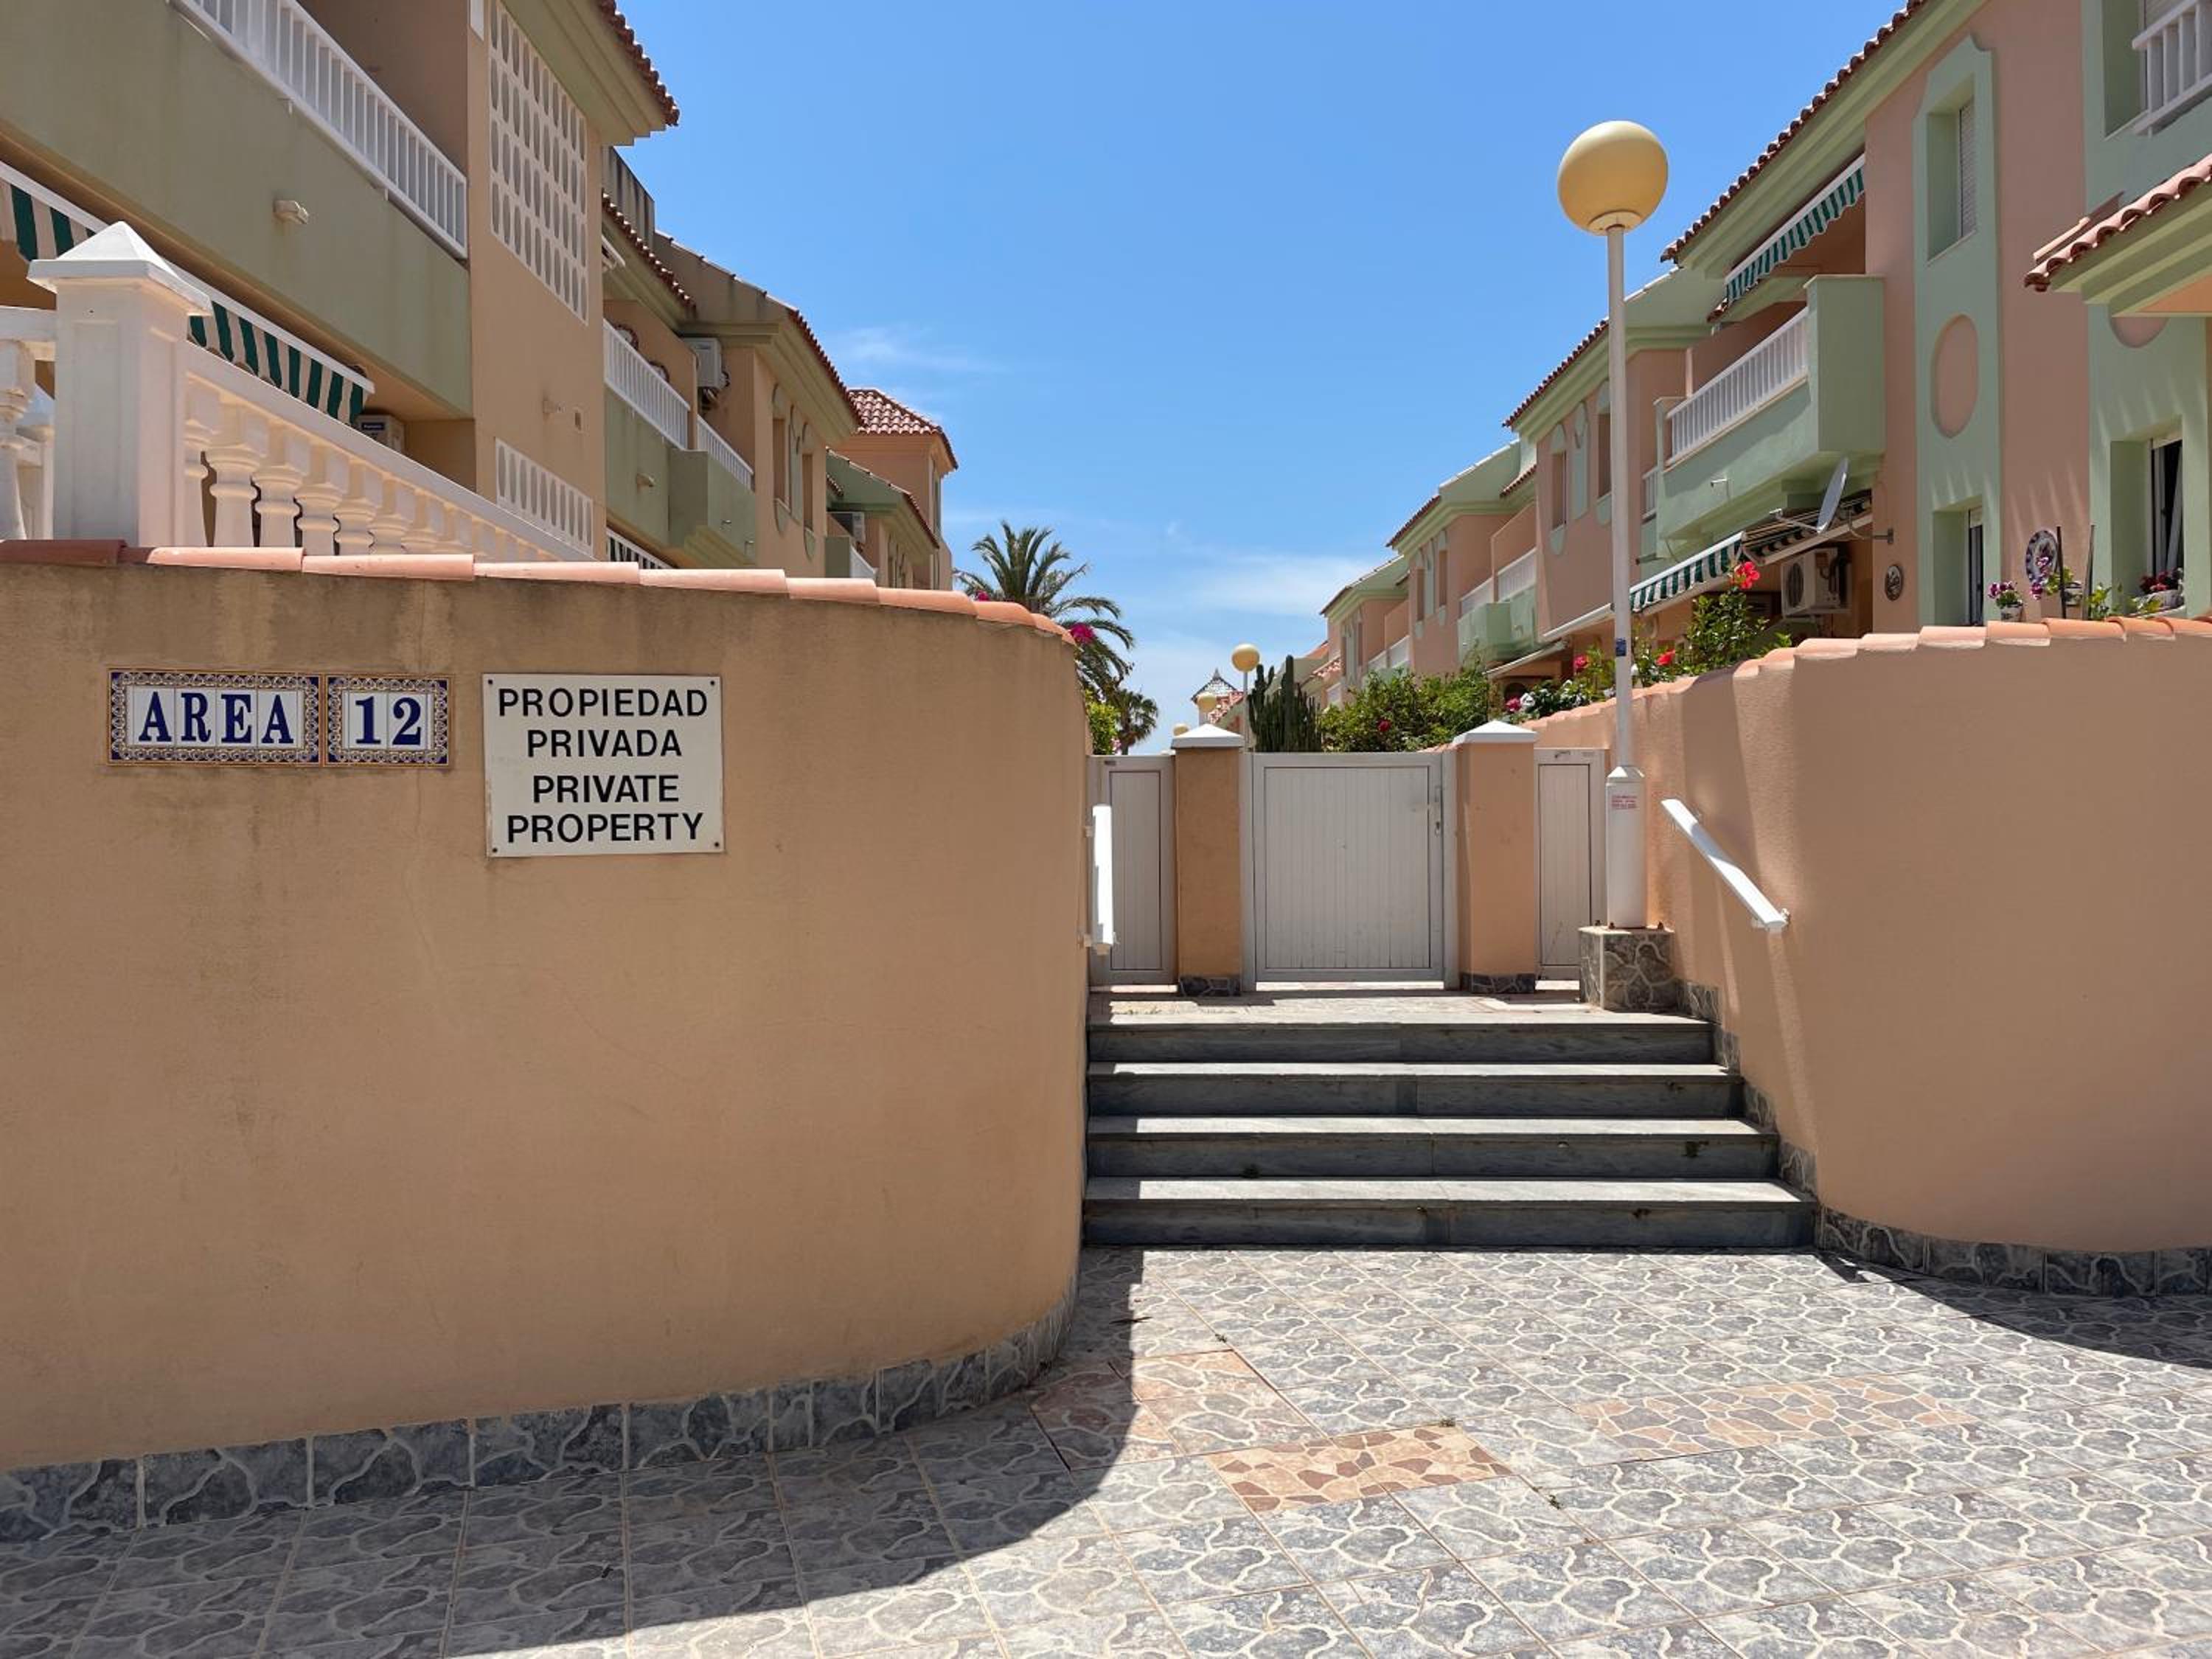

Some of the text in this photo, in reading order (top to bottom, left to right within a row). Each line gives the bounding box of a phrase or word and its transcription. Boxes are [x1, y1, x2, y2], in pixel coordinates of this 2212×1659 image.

[498, 687, 708, 717] PROPIEDAD
[138, 691, 422, 746] AREA 12
[527, 729, 682, 758] PRIVADA
[533, 774, 679, 804] PRIVATE
[507, 813, 703, 844] PROPERTY
